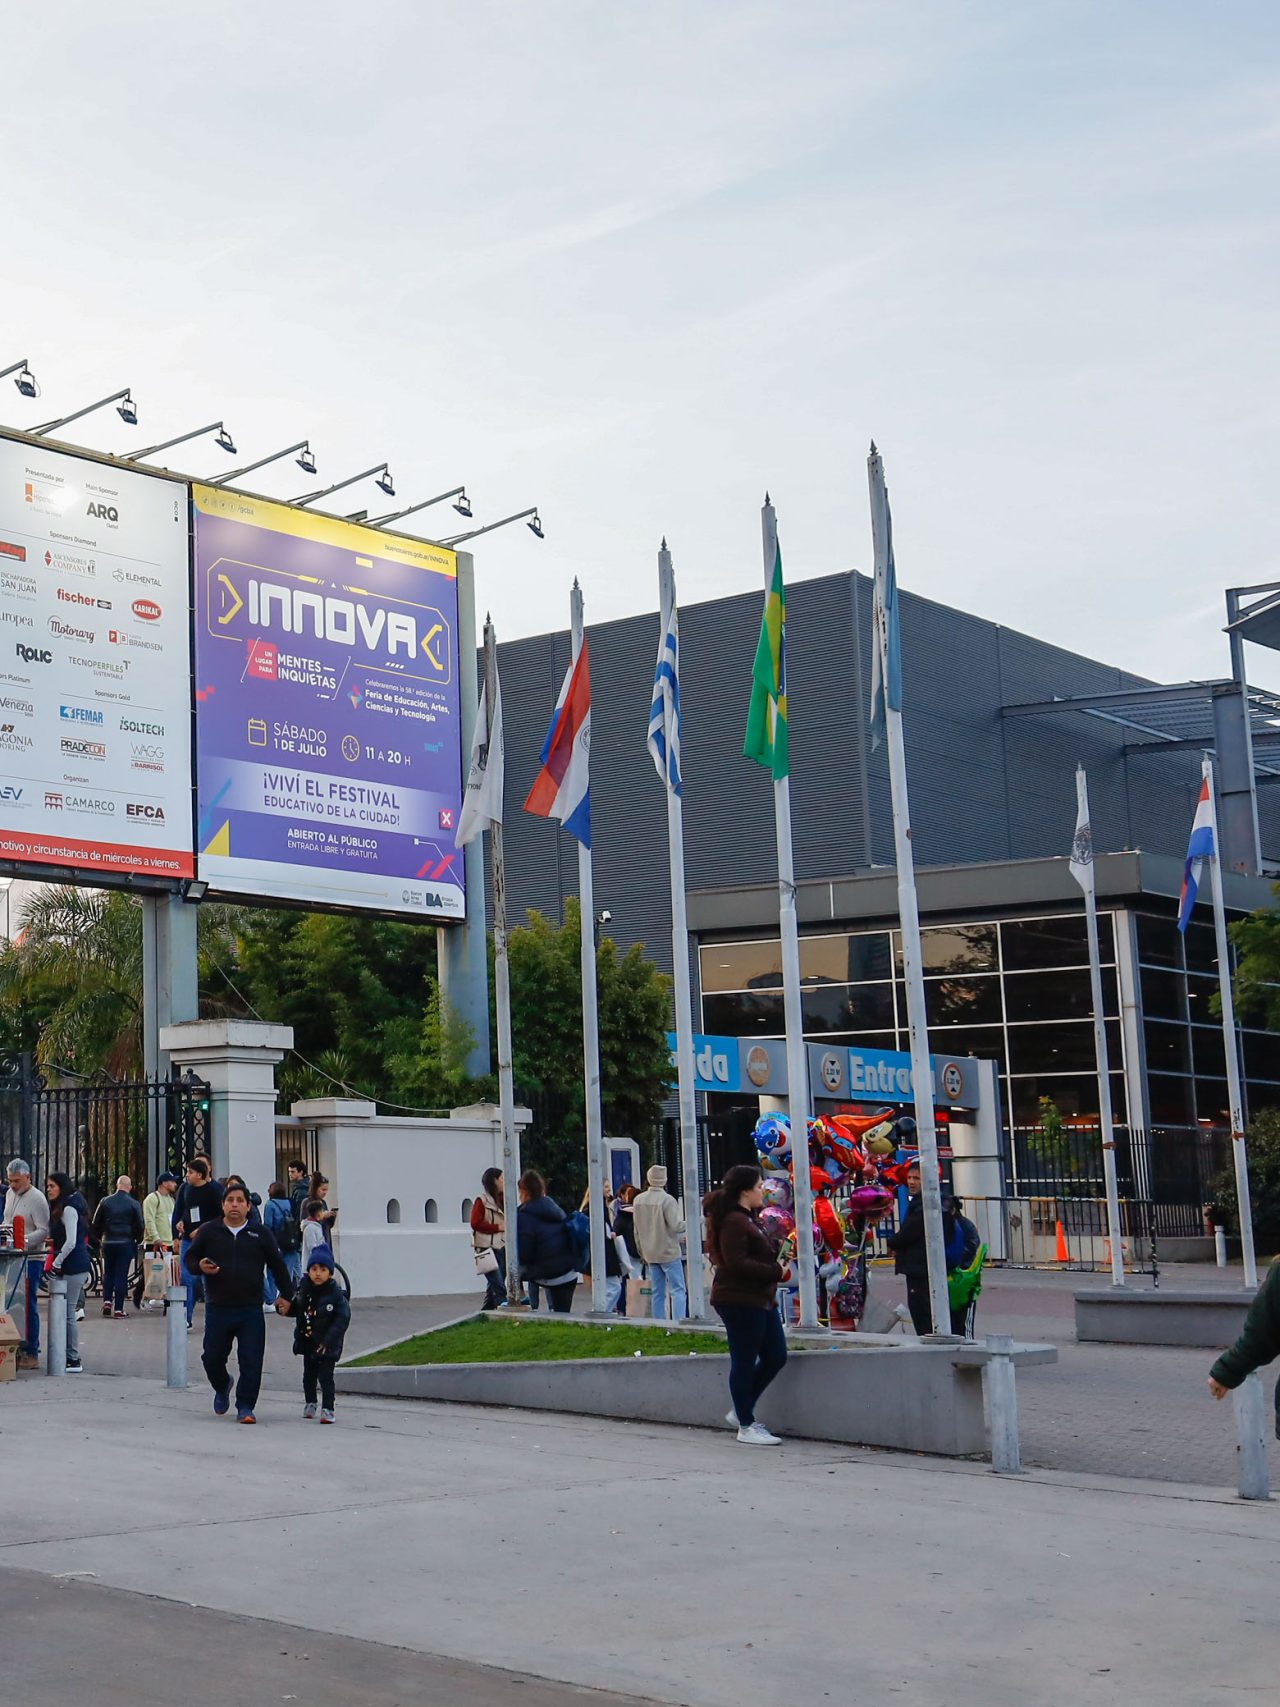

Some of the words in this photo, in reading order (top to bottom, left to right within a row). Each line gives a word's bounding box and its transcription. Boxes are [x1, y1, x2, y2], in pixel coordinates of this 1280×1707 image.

[86, 502, 118, 522] ARQ
[49, 530, 73, 543] Sponsors
[74, 536, 97, 547] Diamond
[53, 561, 87, 574] COMPANY
[1, 579, 17, 590] SAN
[18, 581, 37, 594] JUAN
[125, 572, 162, 587] ELEMENTAL
[56, 588, 96, 607] fischer
[133, 603, 160, 616] KARIKAL
[50, 620, 95, 644] Motorarg
[129, 638, 163, 652] BRANDSEN
[68, 656, 123, 673] TECNOPERFILES
[277, 653, 321, 672] MENTES
[278, 667, 336, 689] INQUIETAS
[94, 689, 118, 700] Sponsors
[365, 689, 382, 699] Feria
[384, 693, 392, 701] de
[394, 695, 429, 710] Educación,
[431, 702, 449, 714] Artes,
[75, 708, 103, 724] FEMAR
[365, 701, 393, 713] Ciencias
[395, 708, 399, 716] y
[400, 707, 436, 722] Tecnología
[273, 721, 327, 744] SÁBADO
[274, 738, 278, 749] 1
[281, 739, 294, 752] DE
[297, 741, 327, 757] JULIO
[365, 746, 375, 759] 11
[377, 750, 384, 761] A
[387, 750, 401, 764] 20
[404, 755, 411, 766] H
[63, 774, 89, 783] Organizan
[263, 772, 299, 794] ¡VIVÍ
[306, 780, 324, 798] EL
[329, 783, 400, 810] FESTIVAL
[65, 796, 115, 812] CAMARCO
[126, 804, 165, 820] EFCA
[264, 796, 324, 814] EDUCATIVO
[327, 804, 341, 817] DE
[344, 807, 356, 818] LA
[359, 810, 400, 826] CIUDAD!
[287, 828, 325, 842] ABIERTO
[327, 834, 339, 845] AL
[341, 833, 377, 849] PÚBLICO
[26, 843, 33, 855] y
[33, 842, 88, 860] circunstancia
[90, 849, 101, 861] de
[102, 850, 142, 866] miércoles
[143, 857, 149, 866] a
[150, 857, 181, 870] viernes.
[287, 840, 319, 852] ENTRADA
[320, 844, 339, 855] LIBRE
[340, 847, 345, 855] Y
[346, 847, 378, 860] GRATUITA
[850, 1055, 936, 1096] Entra
